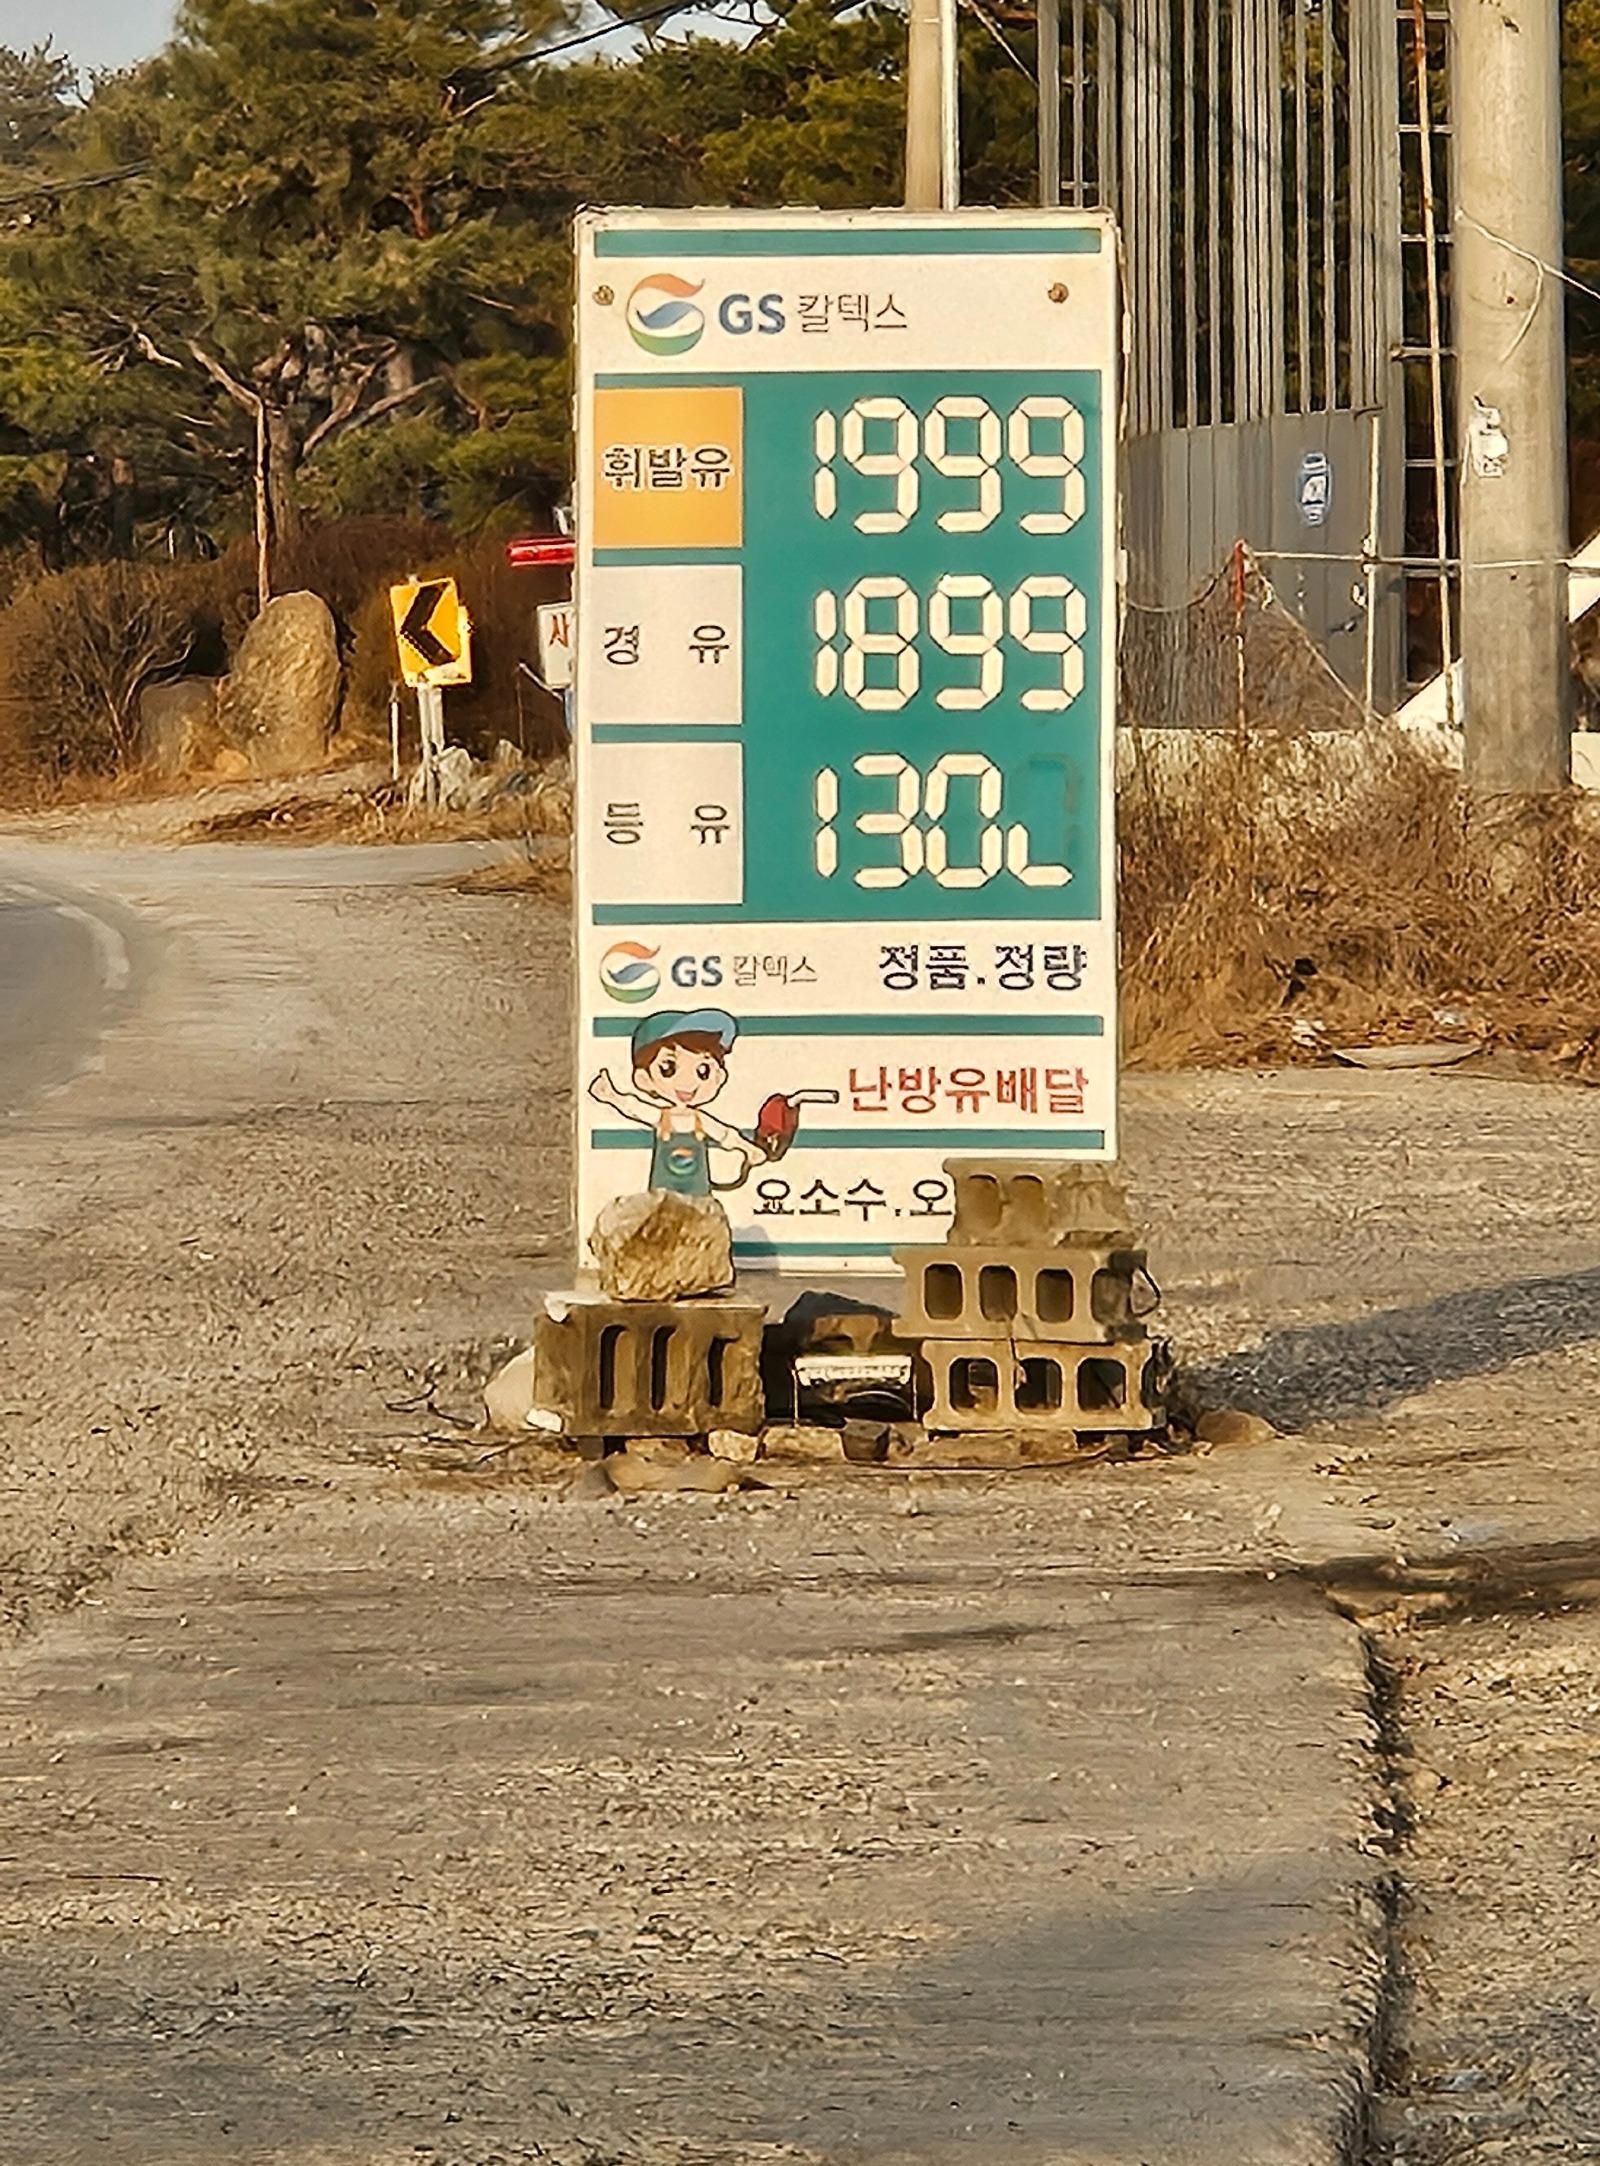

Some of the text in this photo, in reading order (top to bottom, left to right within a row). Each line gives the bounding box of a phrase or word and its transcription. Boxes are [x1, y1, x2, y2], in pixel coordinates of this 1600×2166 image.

[718, 292, 909, 335] GS 칼텍스
[603, 446, 732, 490] 휘발유
[813, 395, 1086, 536] 1999
[814, 574, 1087, 712] 1899
[671, 954, 819, 988] GS 칼텍스
[878, 943, 1088, 992] 정품.정량
[848, 1066, 1090, 1115] 난방유배달
